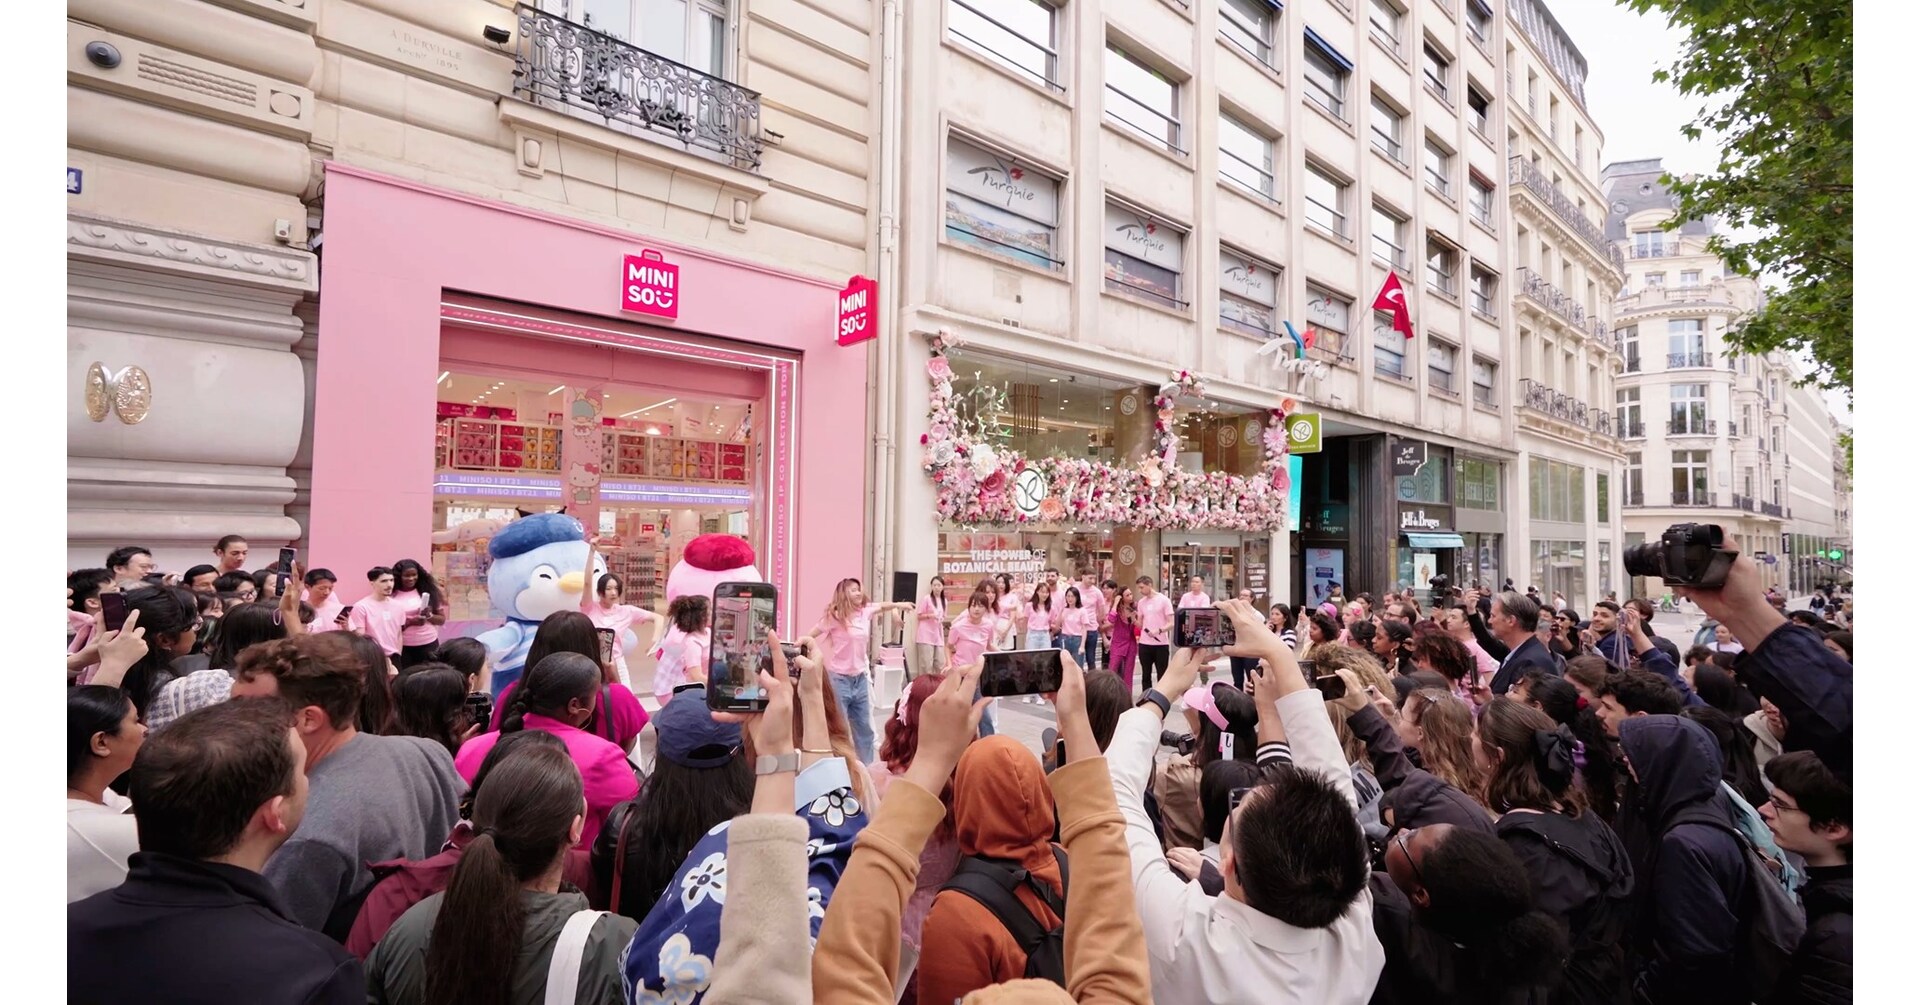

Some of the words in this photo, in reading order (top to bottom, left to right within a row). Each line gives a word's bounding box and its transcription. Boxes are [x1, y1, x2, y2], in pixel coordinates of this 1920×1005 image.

[967, 166, 1034, 207] Turquie
[1115, 223, 1165, 257] Turquie
[628, 263, 674, 290] MINI
[841, 289, 867, 315] MINI
[1401, 447, 1414, 455] Jeff
[459, 476, 492, 484] MINISO
[477, 488, 509, 496] MINISO
[971, 549, 991, 560] THE
[993, 549, 1031, 560] POWER
[1032, 549, 1046, 560] OF
[944, 562, 1006, 573] BOTANICAL
[1007, 562, 1046, 572] BEAUTY
